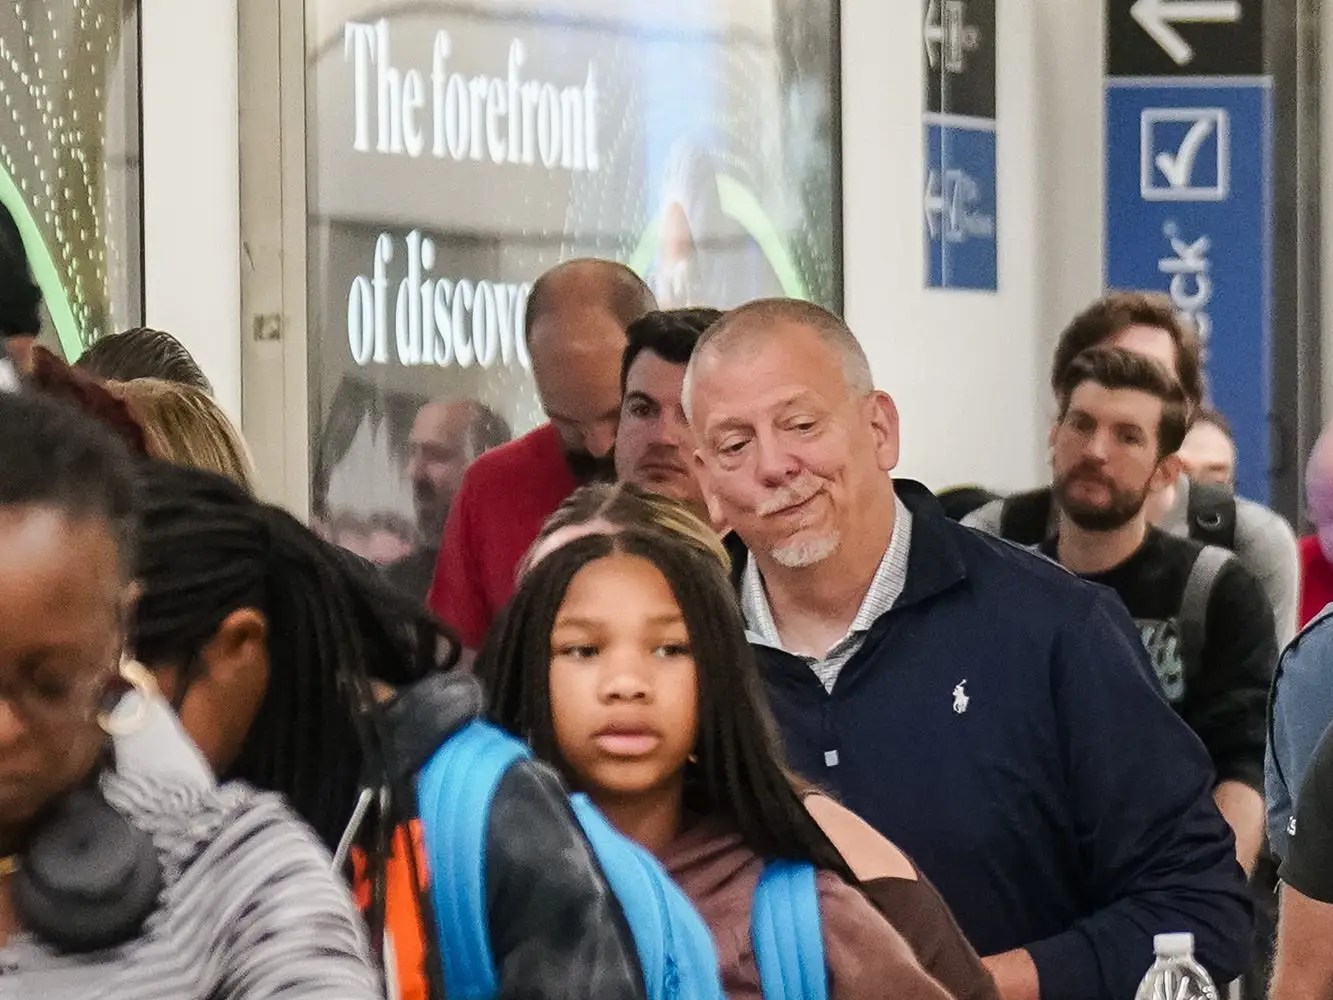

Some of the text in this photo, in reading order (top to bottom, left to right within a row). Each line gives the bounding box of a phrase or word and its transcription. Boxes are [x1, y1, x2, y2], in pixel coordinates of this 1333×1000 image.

[344, 17, 599, 172] The forefront
[348, 232, 394, 367] of
